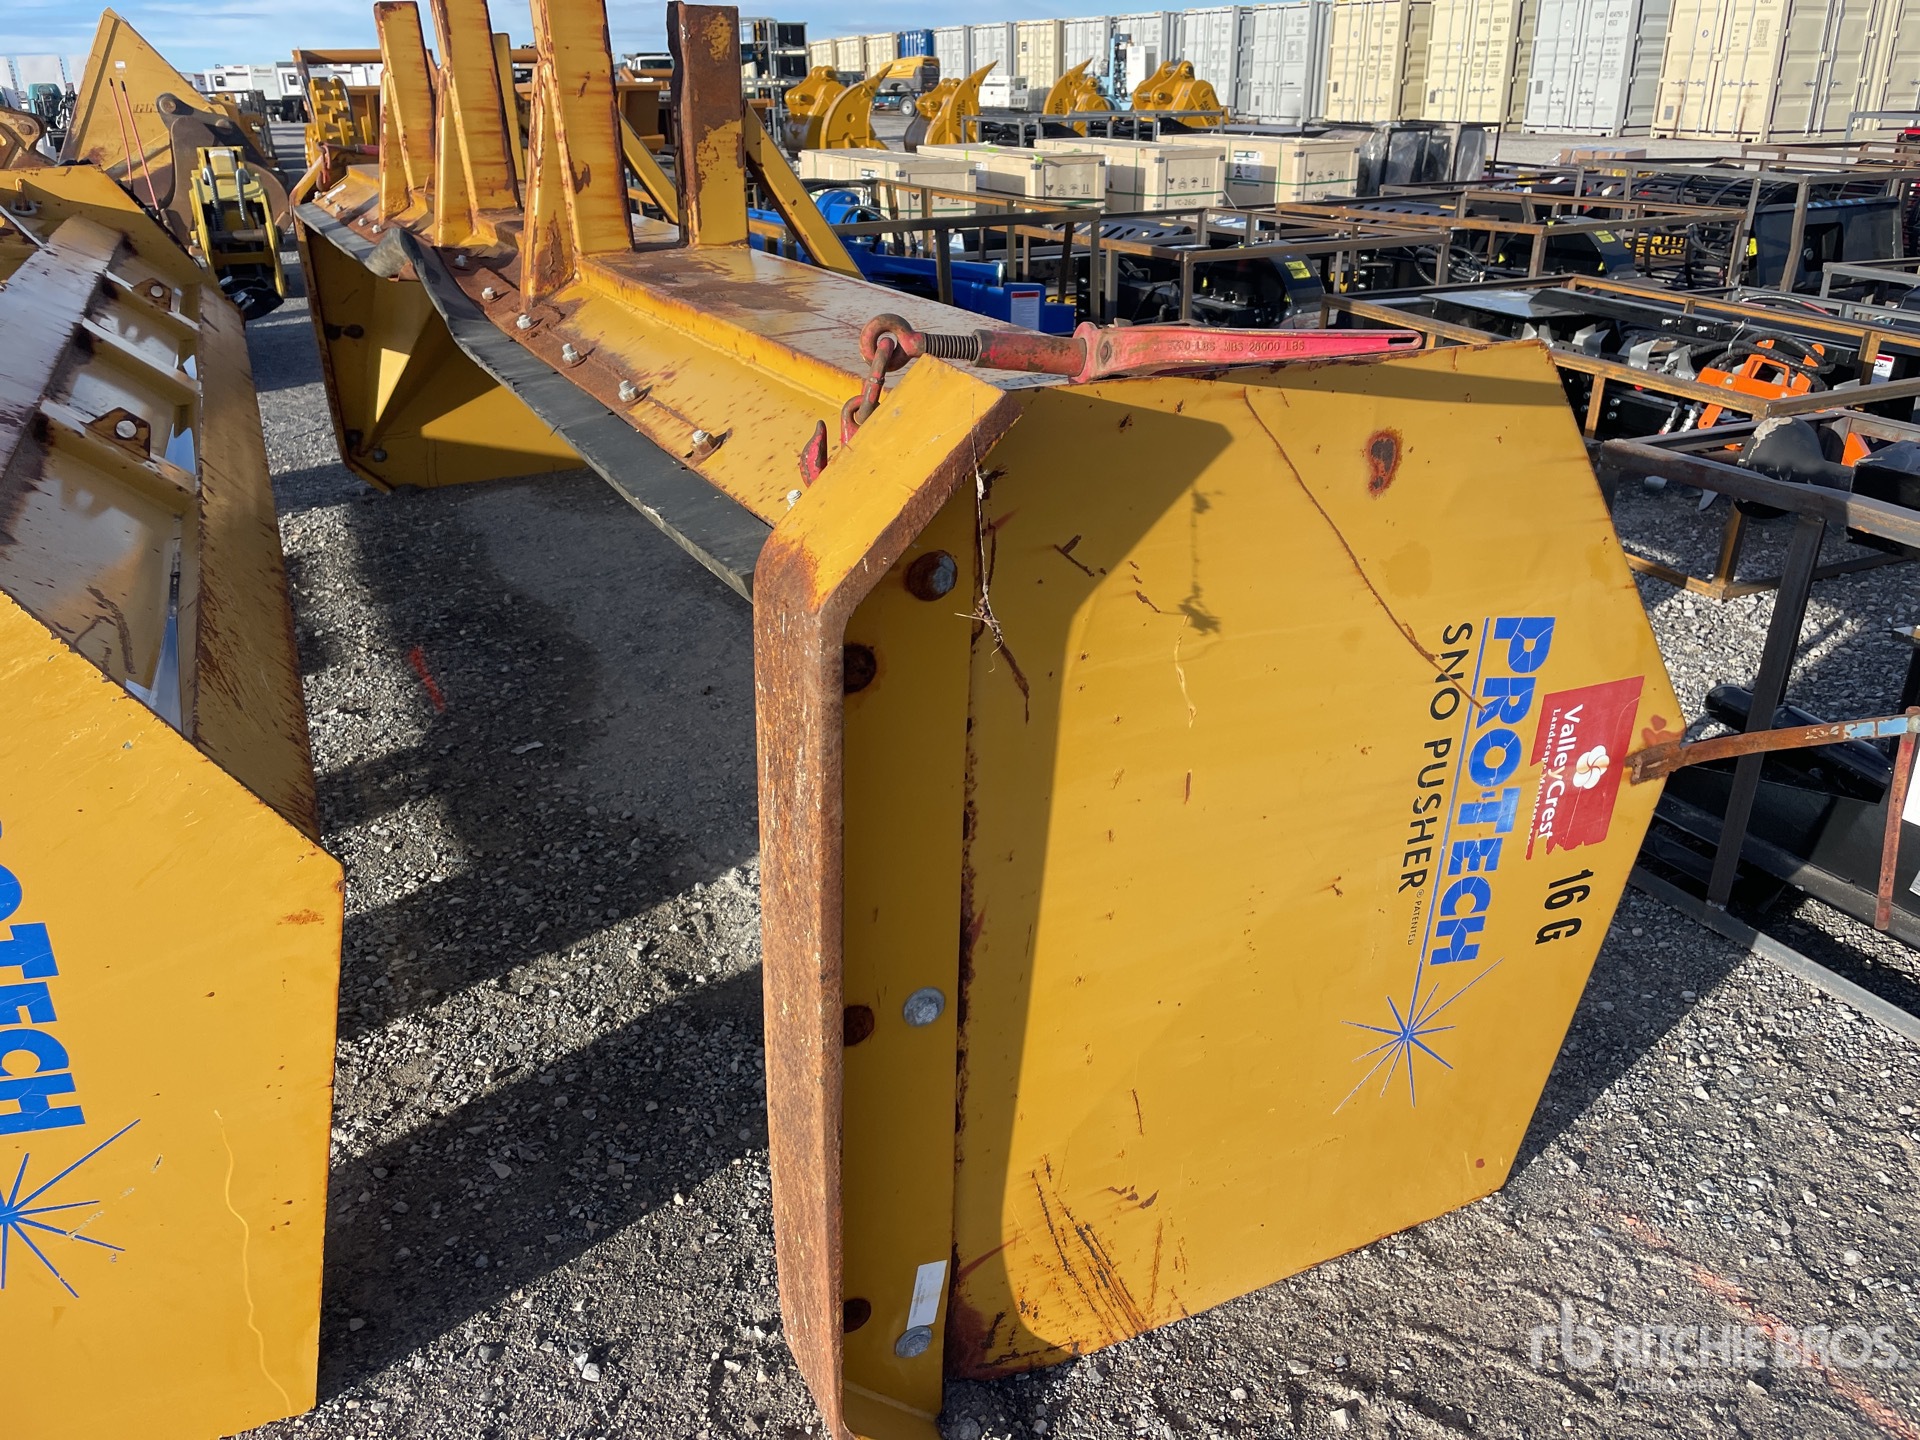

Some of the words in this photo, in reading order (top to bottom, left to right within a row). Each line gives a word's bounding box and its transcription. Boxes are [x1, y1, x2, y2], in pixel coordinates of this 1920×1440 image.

[1430, 622, 1473, 721] SNO
[1537, 703, 1584, 840] ValleyCrest
[1543, 868, 1595, 911] 16
[1534, 916, 1582, 945] G
